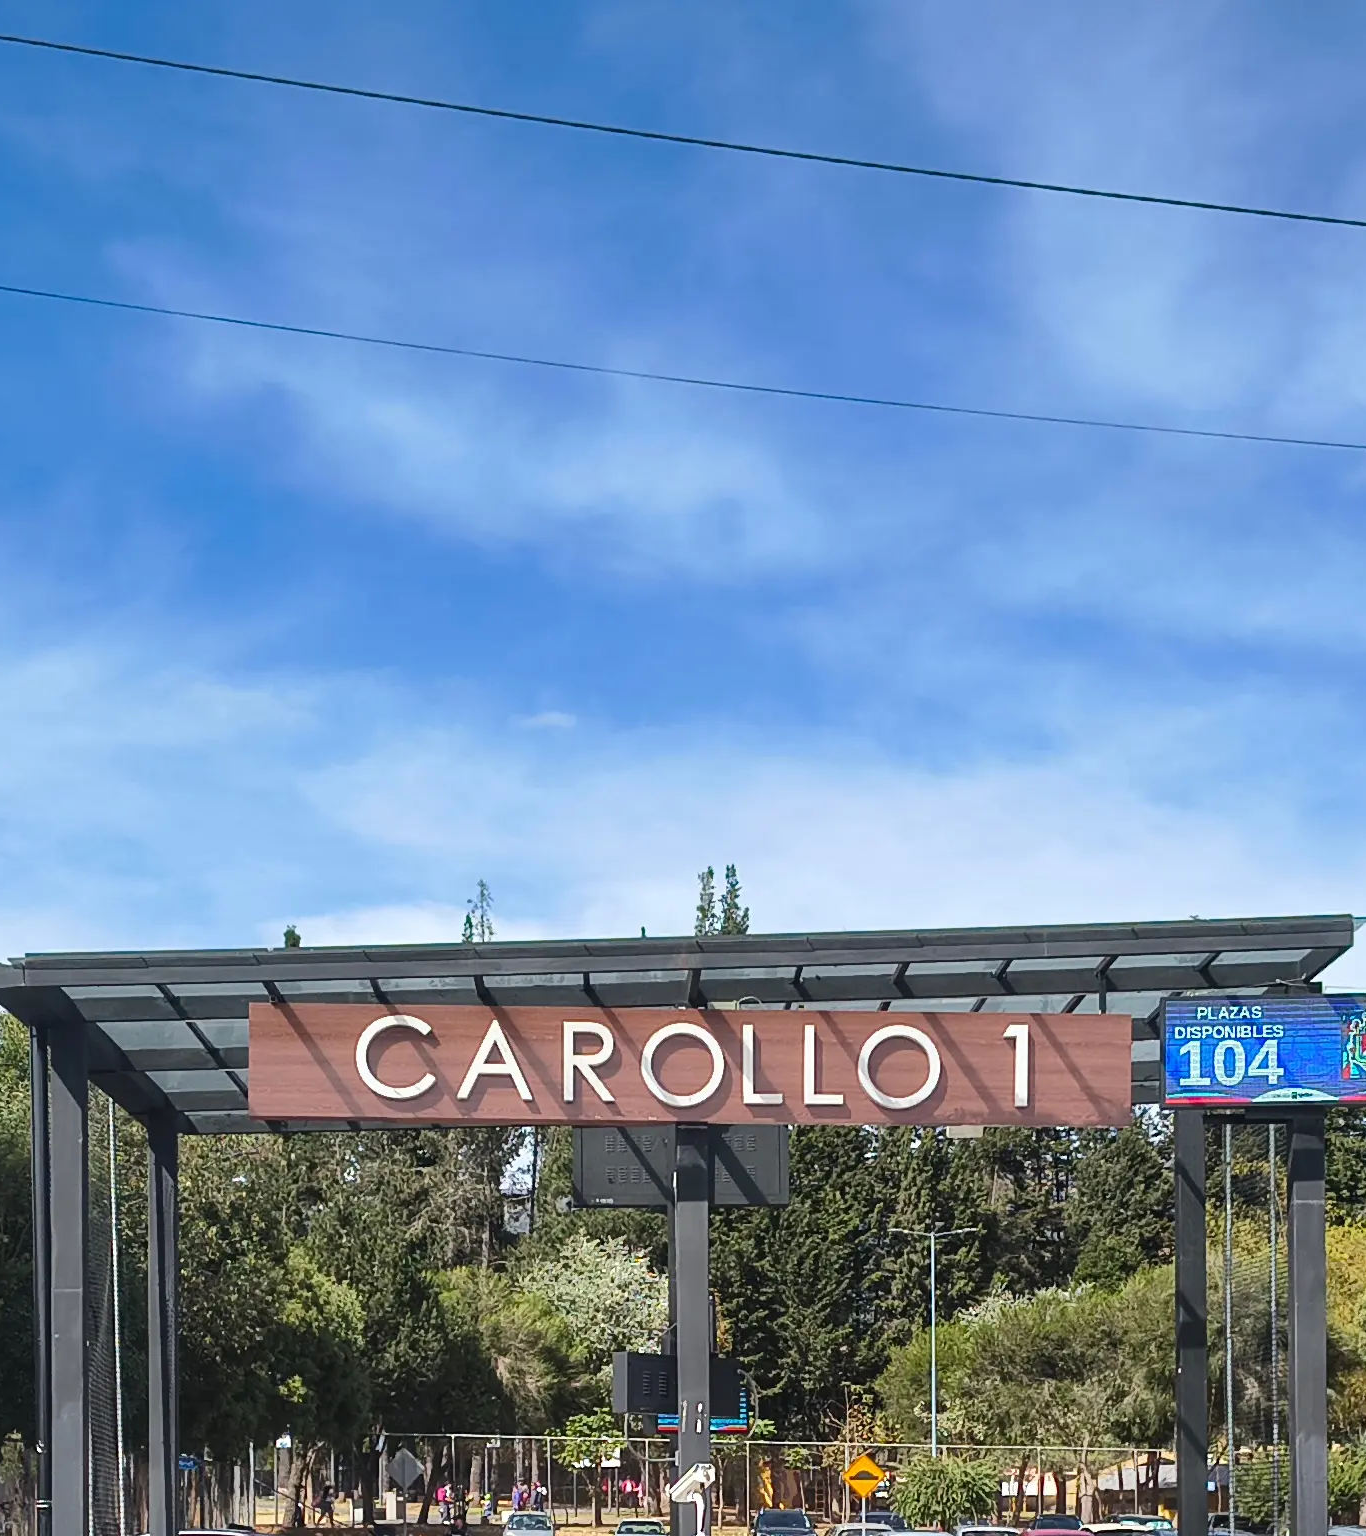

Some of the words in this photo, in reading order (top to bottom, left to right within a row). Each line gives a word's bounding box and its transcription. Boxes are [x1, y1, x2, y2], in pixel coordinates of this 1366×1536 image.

[1197, 1006, 1262, 1020] PLAZAS
[1175, 1025, 1284, 1039] DISPONIBLES
[354, 1013, 942, 1110] CAROLLO
[1002, 1023, 1030, 1108] 1
[1179, 1040, 1284, 1086] 104
